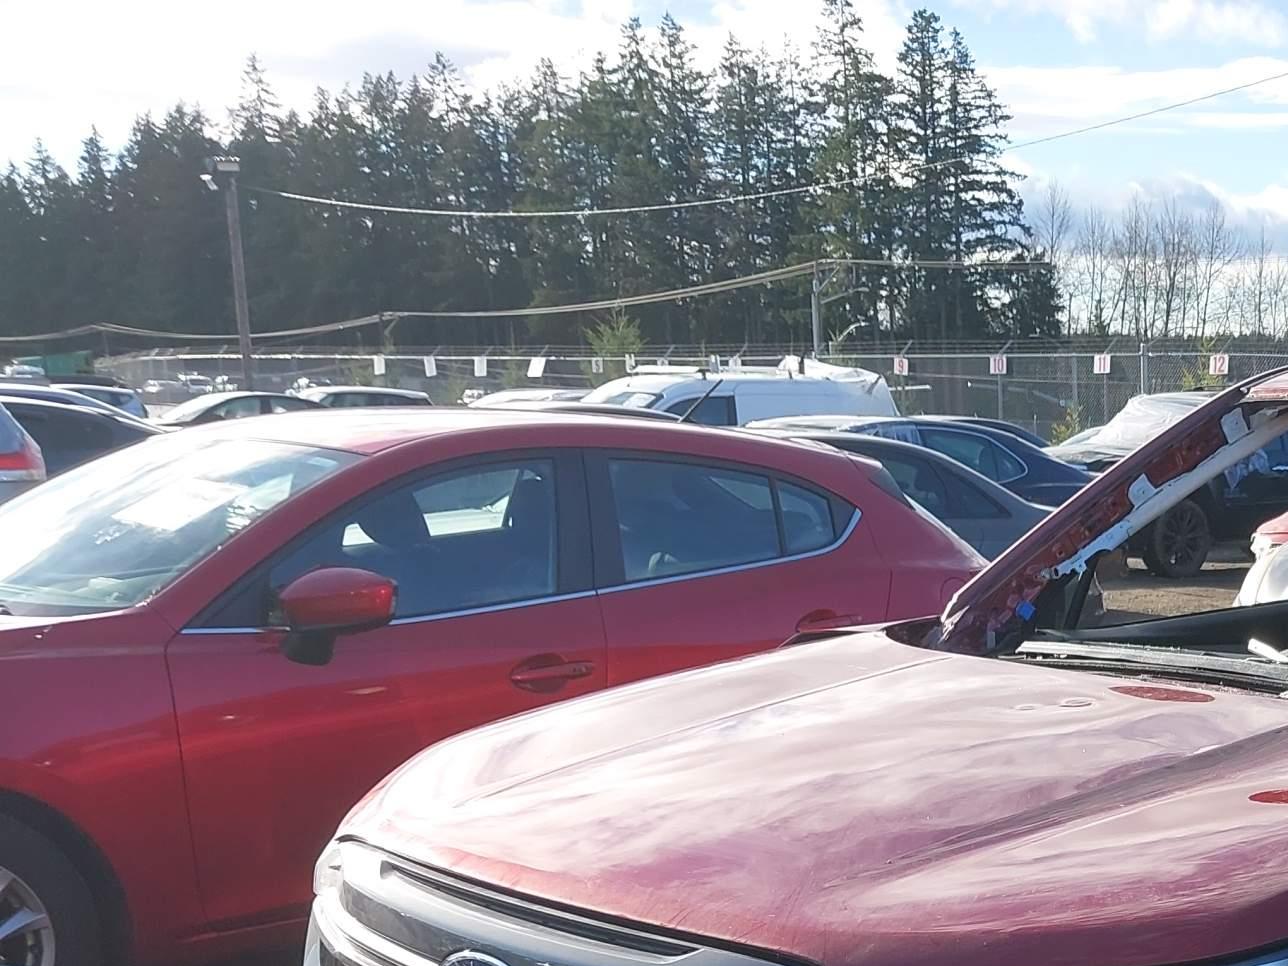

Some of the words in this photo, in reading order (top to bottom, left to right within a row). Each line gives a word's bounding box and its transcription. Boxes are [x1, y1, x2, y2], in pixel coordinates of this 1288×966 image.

[898, 360, 904, 373] 9
[993, 358, 1004, 373] 10
[1097, 356, 1107, 373] 11
[1214, 356, 1226, 373] 12
